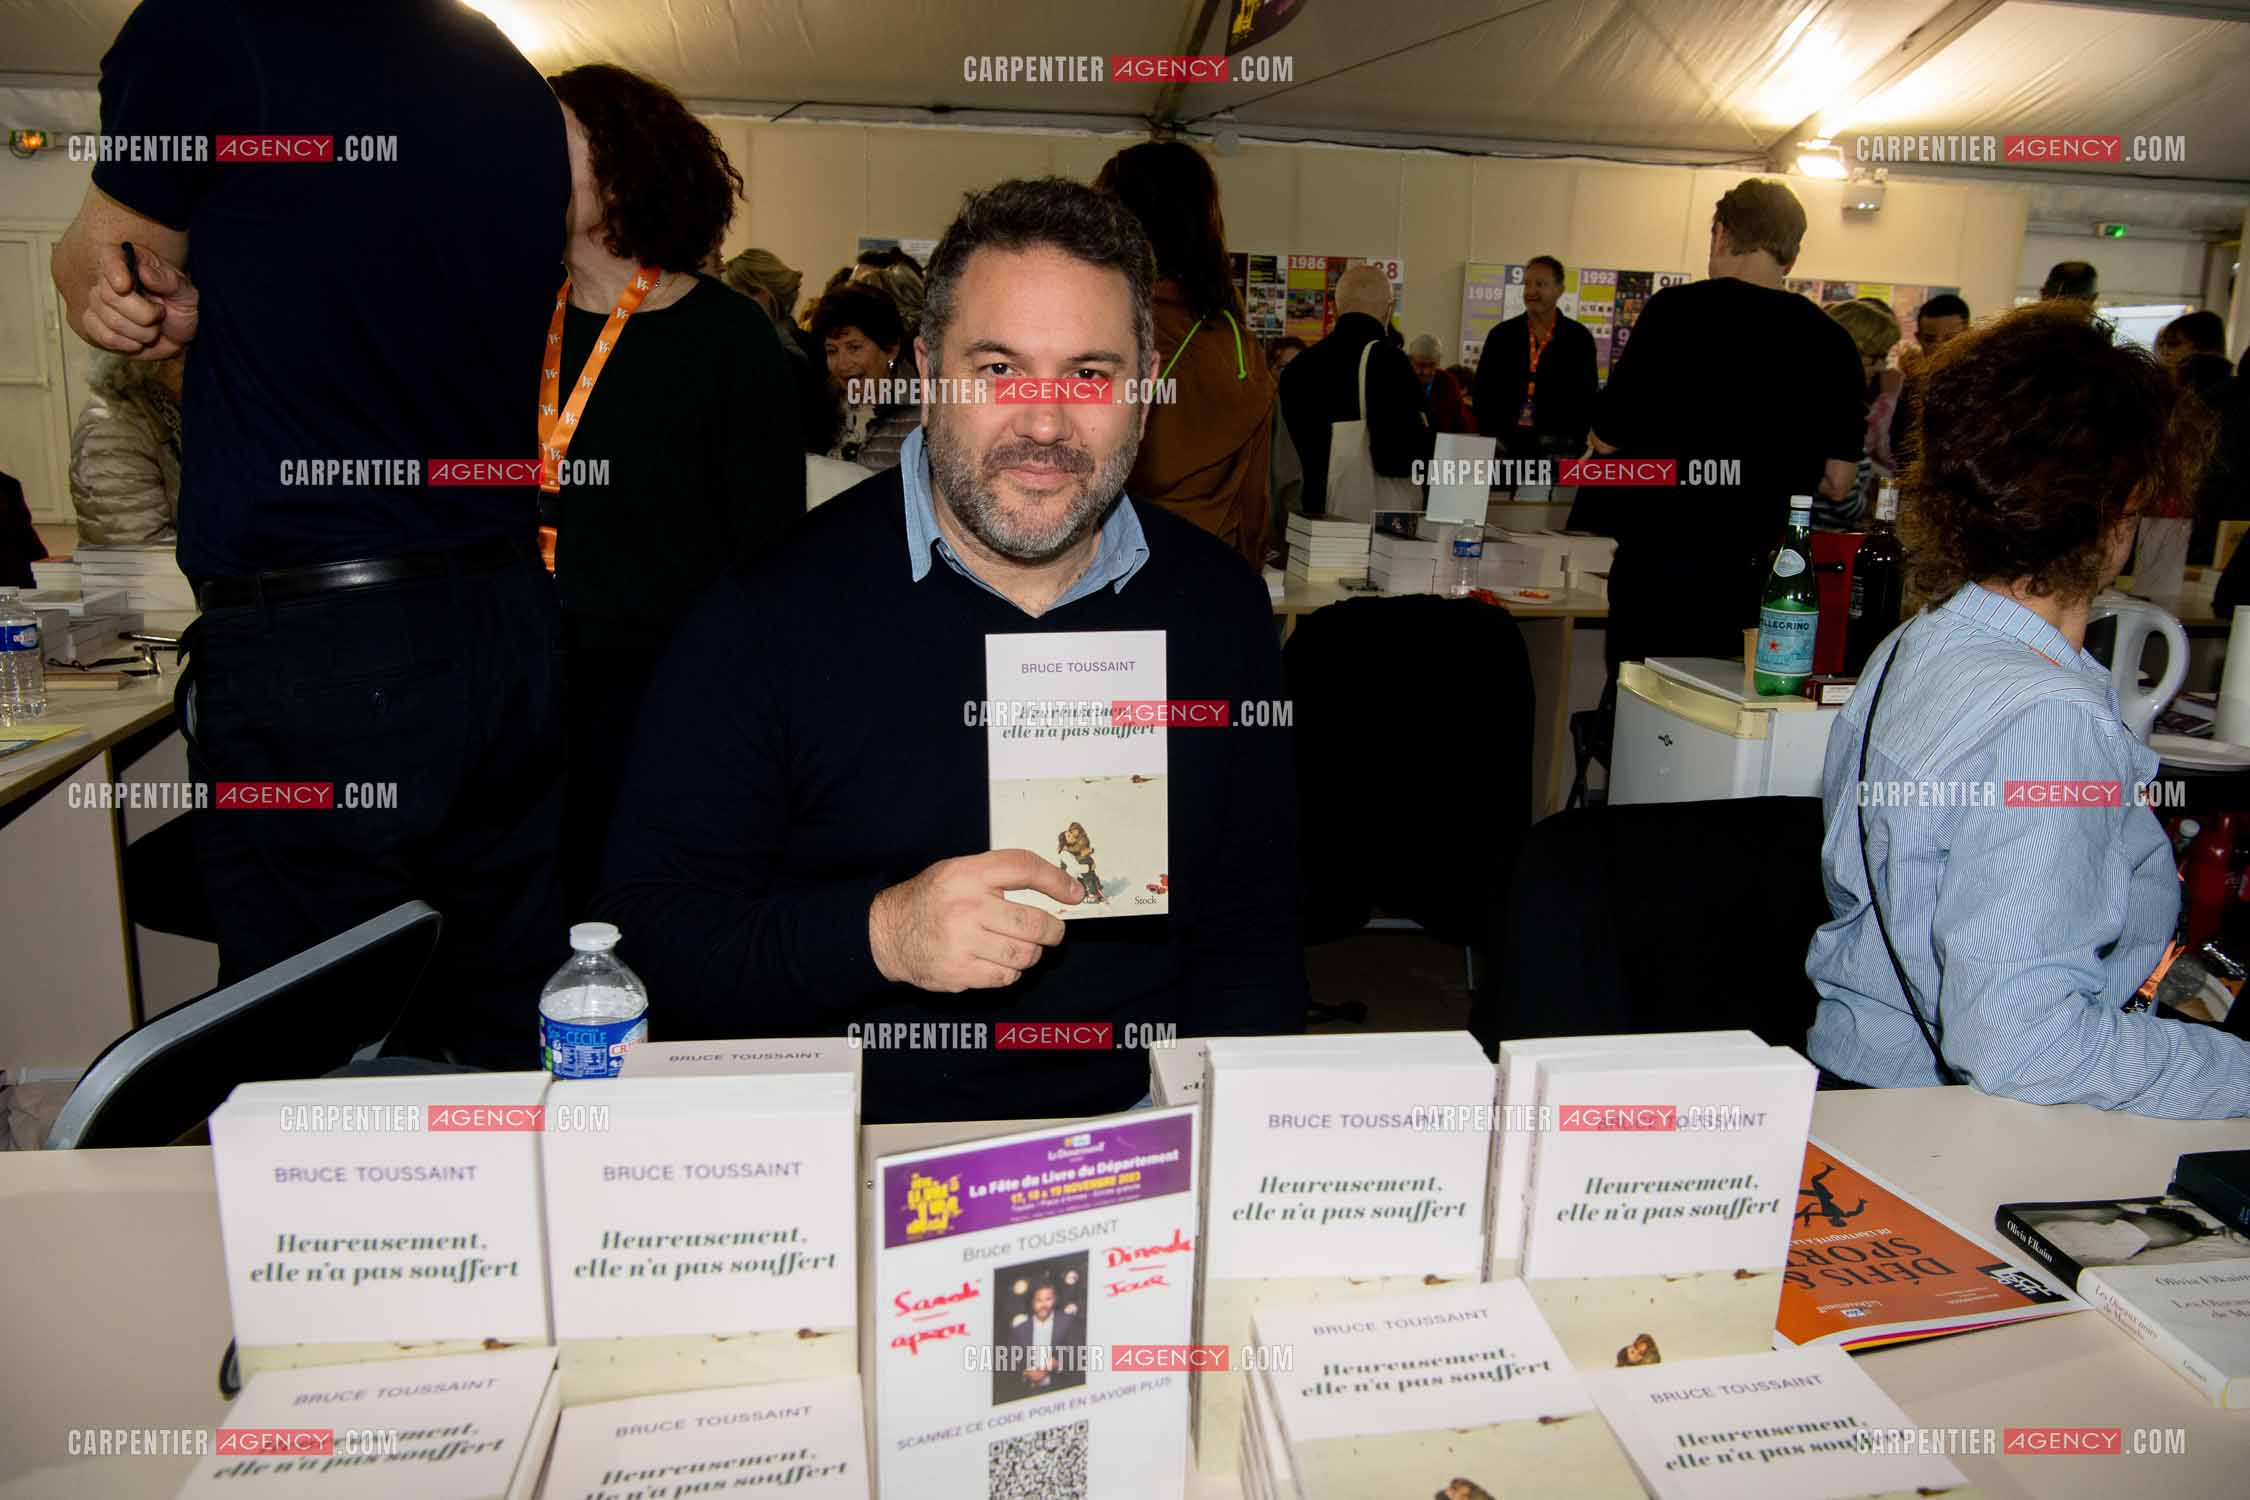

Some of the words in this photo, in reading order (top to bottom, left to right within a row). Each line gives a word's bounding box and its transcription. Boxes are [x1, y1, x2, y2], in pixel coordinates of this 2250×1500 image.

[1291, 256, 1326, 270] 1986
[1022, 663, 1063, 673] BRUCE
[1067, 661, 1136, 673] TOUSSAINT
[1002, 725, 1031, 739] elle
[1035, 723, 1057, 738] n'a
[1061, 726, 1090, 741] pas
[1093, 722, 1156, 739] souffert
[1134, 896, 1158, 905] Stock
[669, 1054, 723, 1062] BRUCE
[731, 1052, 822, 1061] TOUSSAINT
[1268, 1114, 1332, 1129] BRUCE
[274, 1166, 347, 1183] BRUCE
[357, 1165, 478, 1182] TOUSSAINT
[603, 1165, 674, 1182] BRUCE
[684, 1162, 803, 1179] TOUSSAINT
[988, 1178, 1020, 1194] Fête
[1042, 1167, 1076, 1186] Livre
[1097, 1150, 1179, 1177] Département
[1259, 1175, 1443, 1194] Heureusement,
[1584, 1173, 1760, 1195] Heureusement,
[1232, 1201, 1276, 1222] elle
[1281, 1201, 1315, 1221] n'a
[1321, 1205, 1365, 1226] pas
[1370, 1199, 1467, 1223] souffert
[1556, 1202, 1600, 1223] elle
[1603, 1202, 1637, 1221] n'a
[1642, 1204, 1685, 1225] pas
[1690, 1197, 1781, 1220] souffert
[276, 1232, 488, 1253] Heureusement,
[600, 1227, 808, 1250] Heureusement,
[962, 1243, 1011, 1263] Bruce
[1016, 1219, 1120, 1251] TOUSSAINT
[2007, 1220, 2026, 1241] Olivia
[2027, 1235, 2053, 1264] Elkaim
[250, 1262, 300, 1282] elle
[306, 1261, 345, 1281] n'a
[353, 1266, 403, 1287] pas
[409, 1257, 519, 1283] souffert
[574, 1258, 624, 1278] elle
[630, 1257, 667, 1277] n'a
[675, 1260, 724, 1281] pas
[730, 1251, 836, 1276] souffert
[1818, 1257, 1957, 1287] DÉFIS
[1312, 1321, 1377, 1337] BRUCE
[1384, 1308, 1489, 1331] TOUSSAINT
[1322, 1348, 1517, 1377] Heureusement,
[292, 1388, 366, 1406] BRUCE
[376, 1377, 498, 1399] TOUSSAINT
[1301, 1381, 1347, 1398] elle
[1353, 1378, 1390, 1394] n'a
[1398, 1376, 1443, 1393] pas
[1450, 1359, 1552, 1384] souffert
[1649, 1386, 1714, 1405] BRUCE
[1719, 1374, 1824, 1396] TOUSSAINT
[615, 1419, 686, 1438] BRUCE
[696, 1405, 812, 1427] TOUSSAINT
[896, 1426, 963, 1451] SCANNEZ
[966, 1421, 984, 1436] CE
[987, 1412, 1024, 1430] CODE
[1029, 1403, 1066, 1419] POUR
[1069, 1397, 1088, 1410] EN
[1091, 1384, 1137, 1405] SAVOIR
[1141, 1376, 1173, 1393] PLUS
[1676, 1415, 1868, 1448] Heureusement,
[212, 1460, 270, 1480] elle
[273, 1455, 318, 1473] n'a
[320, 1456, 378, 1474] pas
[382, 1438, 505, 1462] souffert
[601, 1448, 817, 1486] Heureusement,
[1664, 1450, 1712, 1472] elle
[1717, 1448, 1754, 1466] n'a
[1760, 1443, 1806, 1464] pas
[673, 1479, 727, 1500] pas
[733, 1461, 849, 1487] souffert
